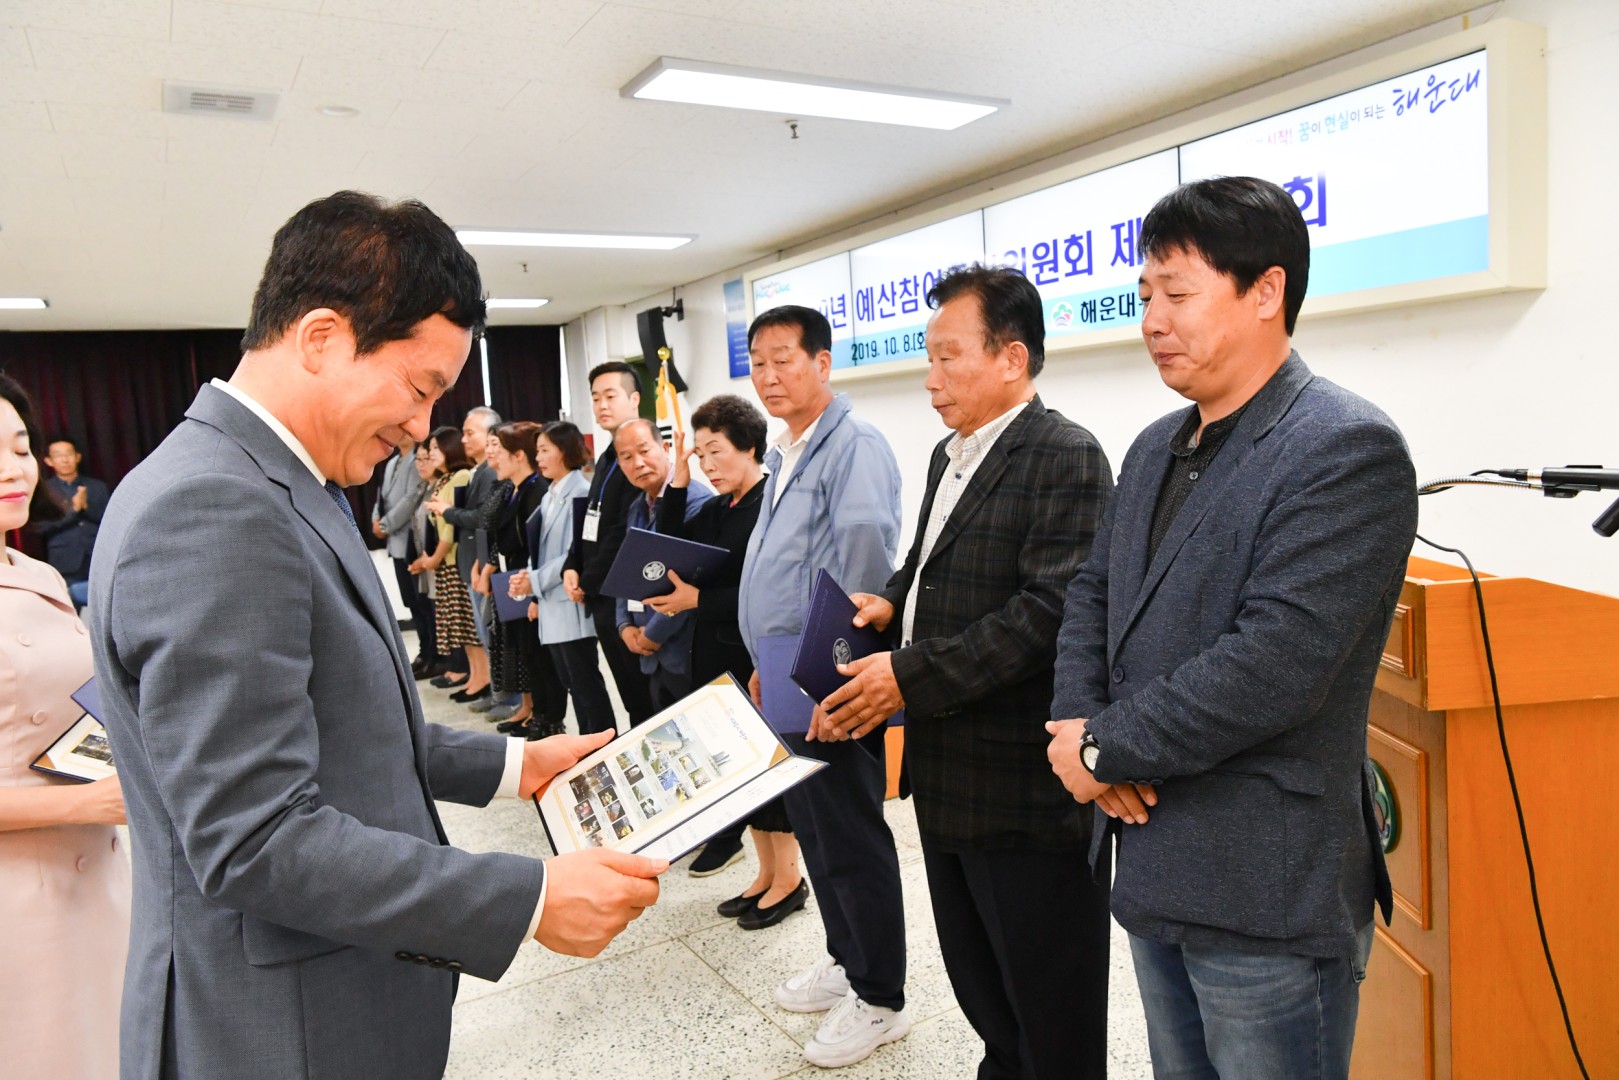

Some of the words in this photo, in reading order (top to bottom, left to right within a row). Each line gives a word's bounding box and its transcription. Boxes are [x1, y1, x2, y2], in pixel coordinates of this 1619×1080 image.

[1298, 120, 1321, 143] 꿈이
[1324, 108, 1360, 135] 현실이
[1362, 103, 1387, 120] 되는
[1392, 68, 1481, 117] 해운대
[817, 293, 847, 329] 0년
[856, 229, 1094, 323] 예산참여위원회
[1110, 215, 1145, 268] 제
[1282, 170, 1327, 227] 회
[1080, 292, 1144, 324] 해운대
[851, 340, 881, 362] 2019.
[884, 336, 900, 356] 10.
[903, 331, 927, 353] 8.(화
